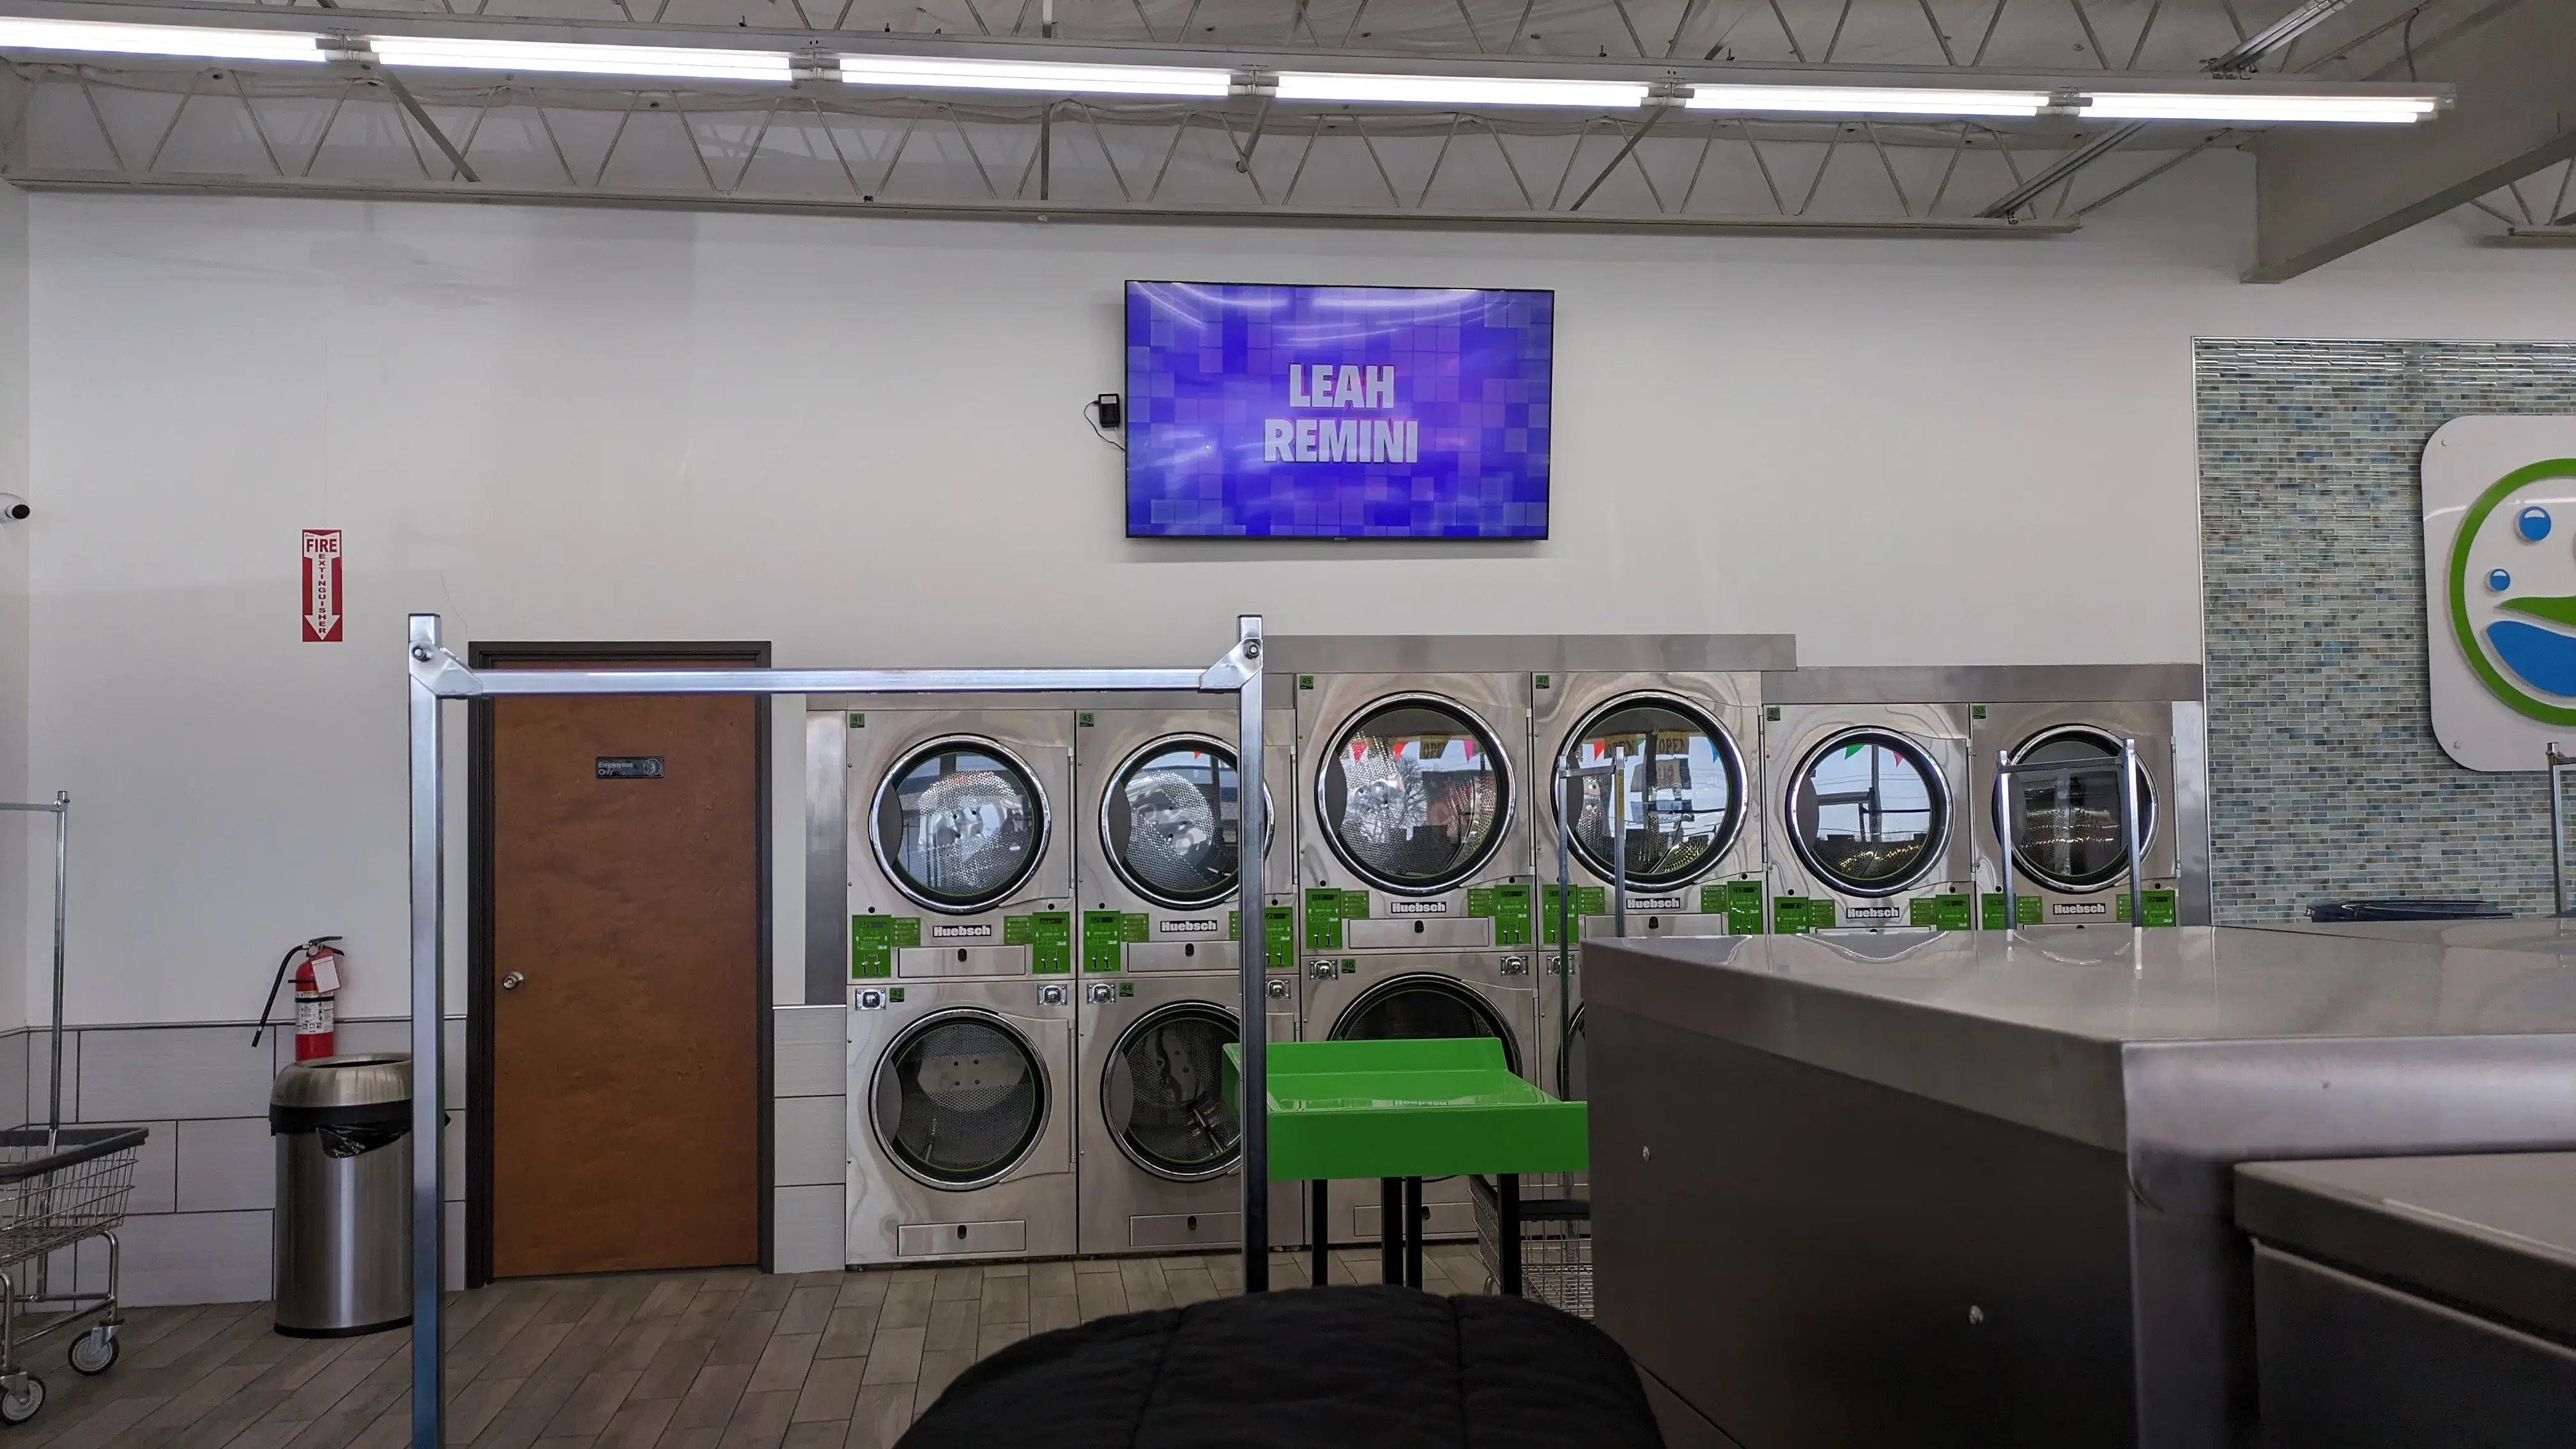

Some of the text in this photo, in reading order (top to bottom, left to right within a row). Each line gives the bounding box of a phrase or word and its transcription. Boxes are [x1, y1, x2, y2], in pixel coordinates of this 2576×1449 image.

[1289, 363, 1395, 409] LEAH
[1264, 418, 1419, 464] REMINI
[306, 539, 337, 553] FIRE
[318, 553, 326, 634] EXTINGUISHER
[1658, 738, 1686, 754] OPEN
[1392, 901, 1446, 912] Huebsch
[1627, 898, 1680, 908] Huebsch
[1847, 907, 1899, 917] Huebsch
[2054, 904, 2105, 914] Huebsch
[933, 925, 990, 936] Huebsch
[1162, 921, 1216, 931] Huebsch
